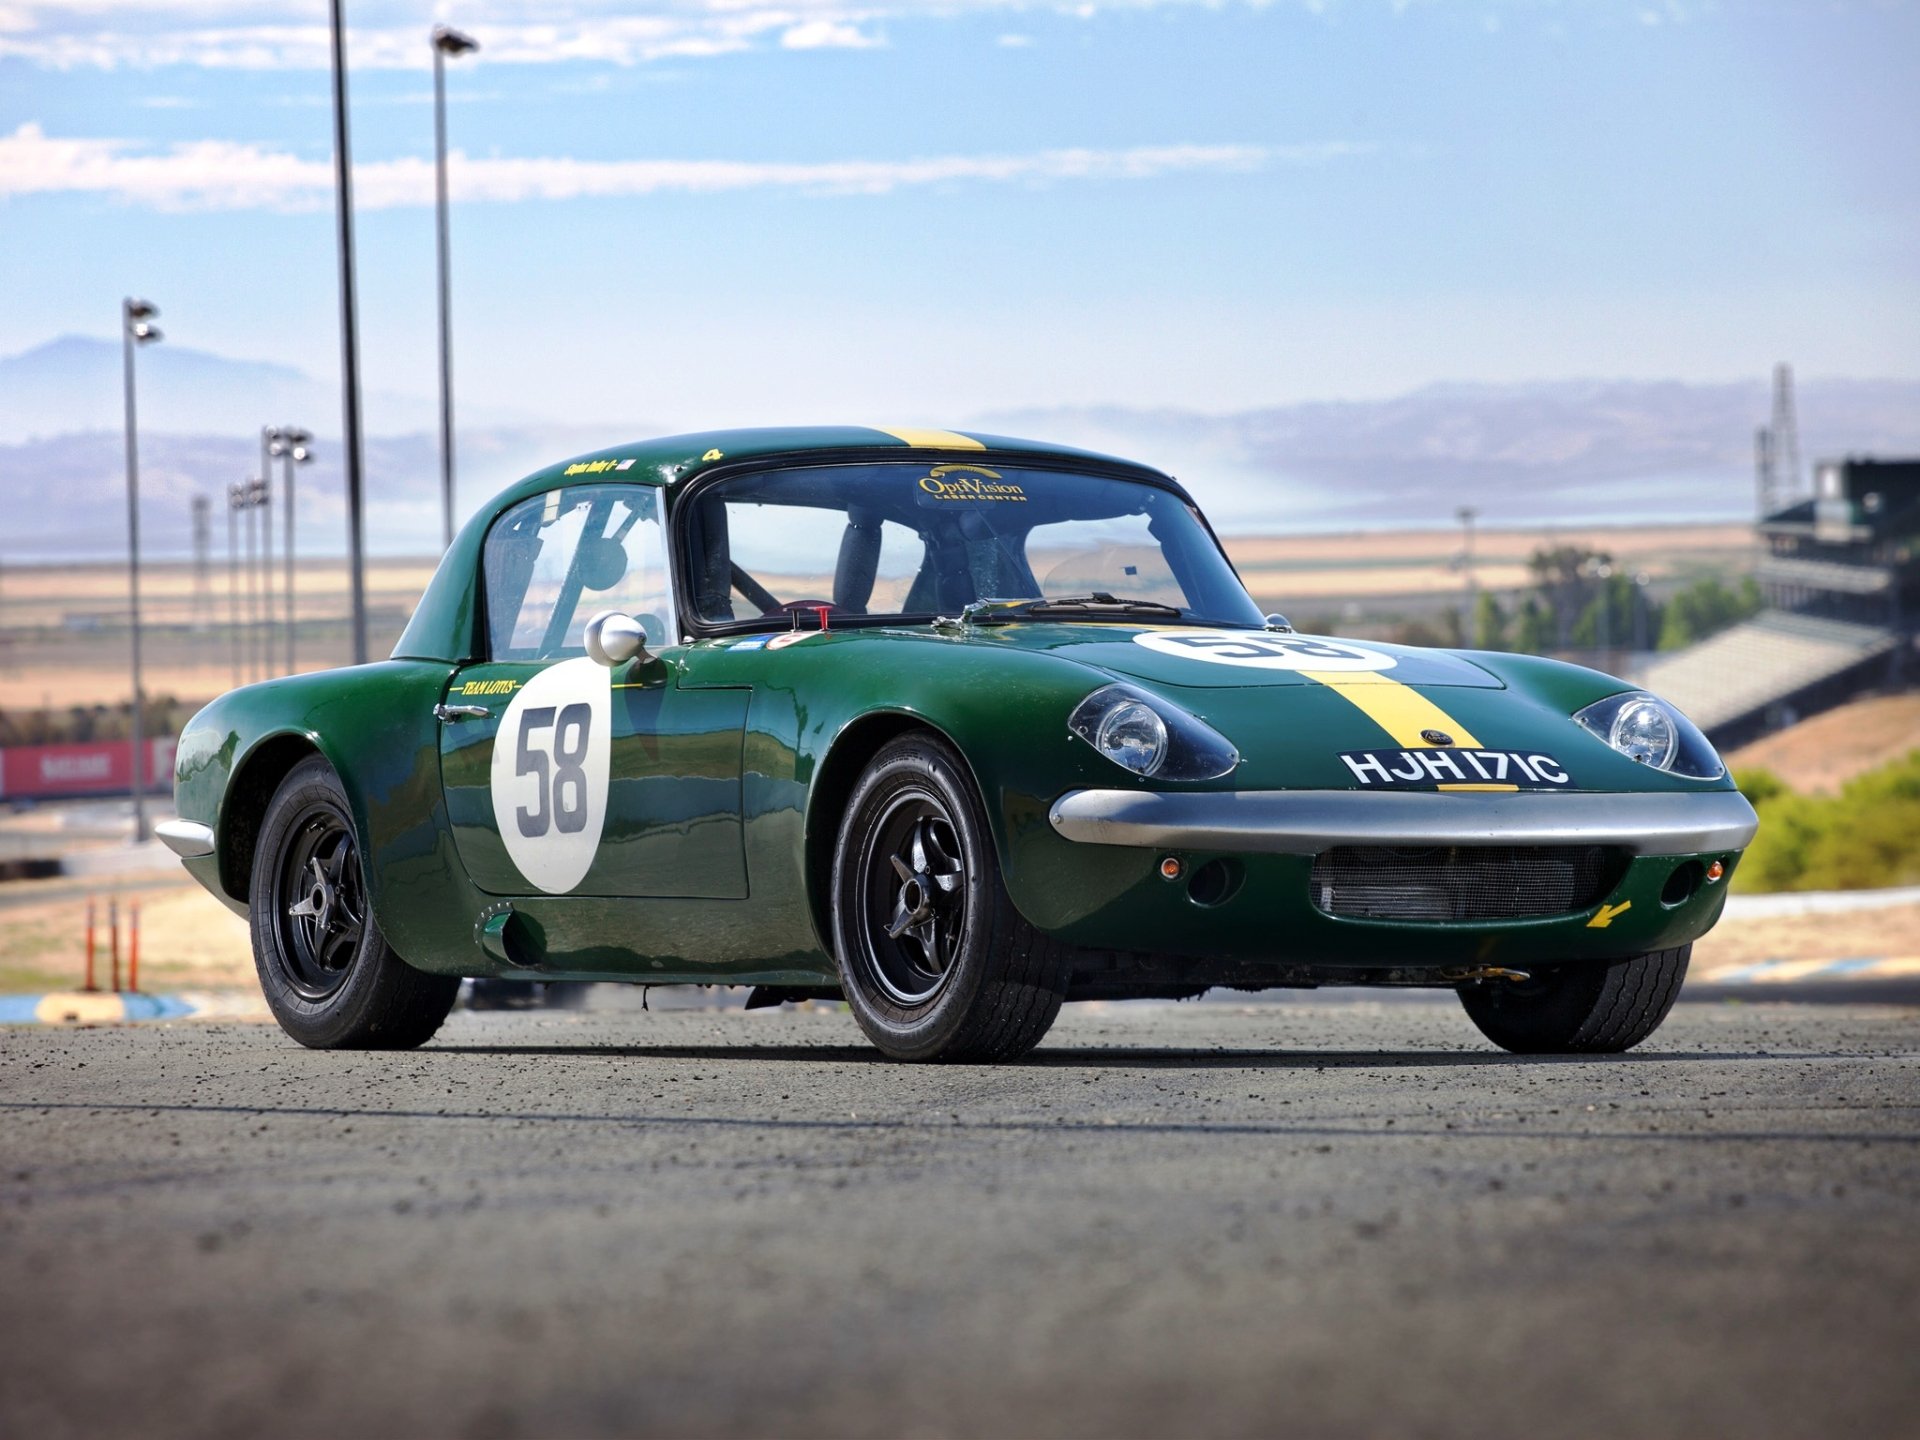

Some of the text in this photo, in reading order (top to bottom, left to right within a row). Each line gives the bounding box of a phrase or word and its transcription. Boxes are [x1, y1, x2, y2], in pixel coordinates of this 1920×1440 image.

[702, 448, 723, 461] 4
[919, 478, 1023, 495] OptiVision
[978, 494, 1028, 502] CENTER
[1157, 636, 1366, 660] 58
[462, 680, 516, 696] TEAM LOTUS
[516, 702, 592, 838] 58
[1340, 751, 1569, 784] HJH 171C
